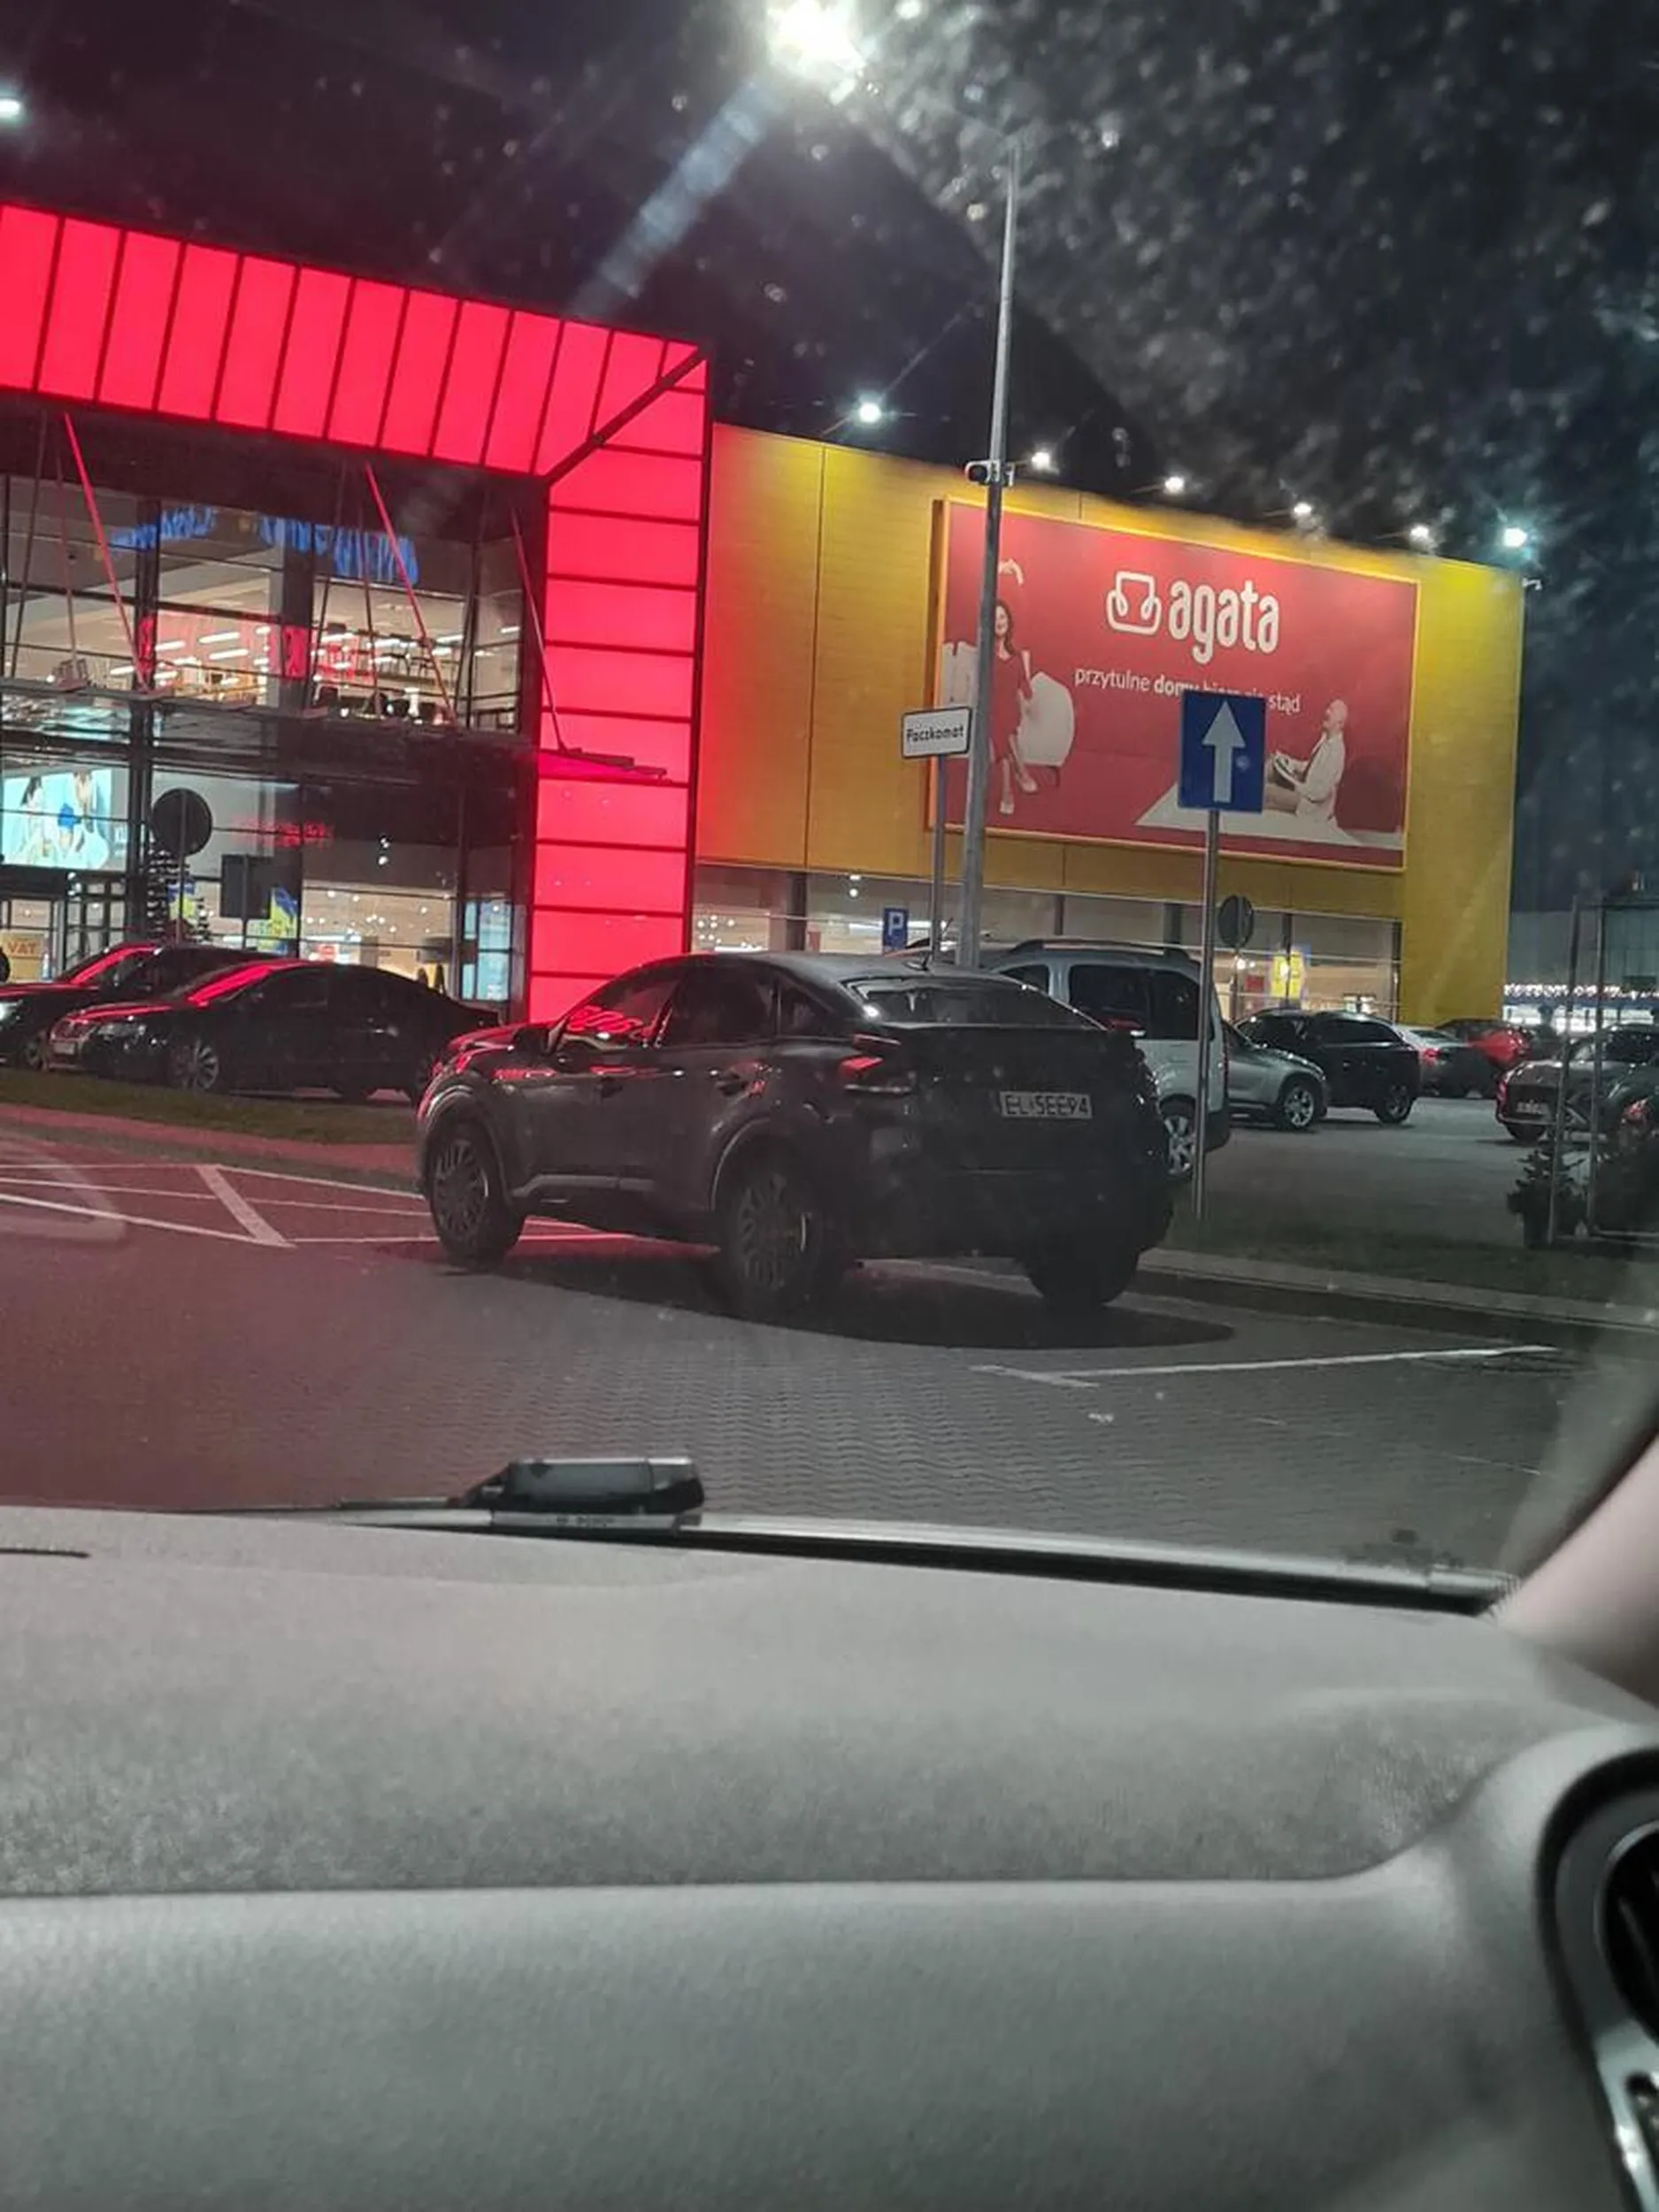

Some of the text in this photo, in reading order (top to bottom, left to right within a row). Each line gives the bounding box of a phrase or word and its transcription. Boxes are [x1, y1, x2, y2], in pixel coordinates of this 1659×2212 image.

[1168, 580, 1279, 664] agata
[1074, 668, 1150, 692] przytulne
[1268, 692, 1301, 716] stąd
[906, 725, 964, 742] Paczkomat
[888, 911, 904, 936] P
